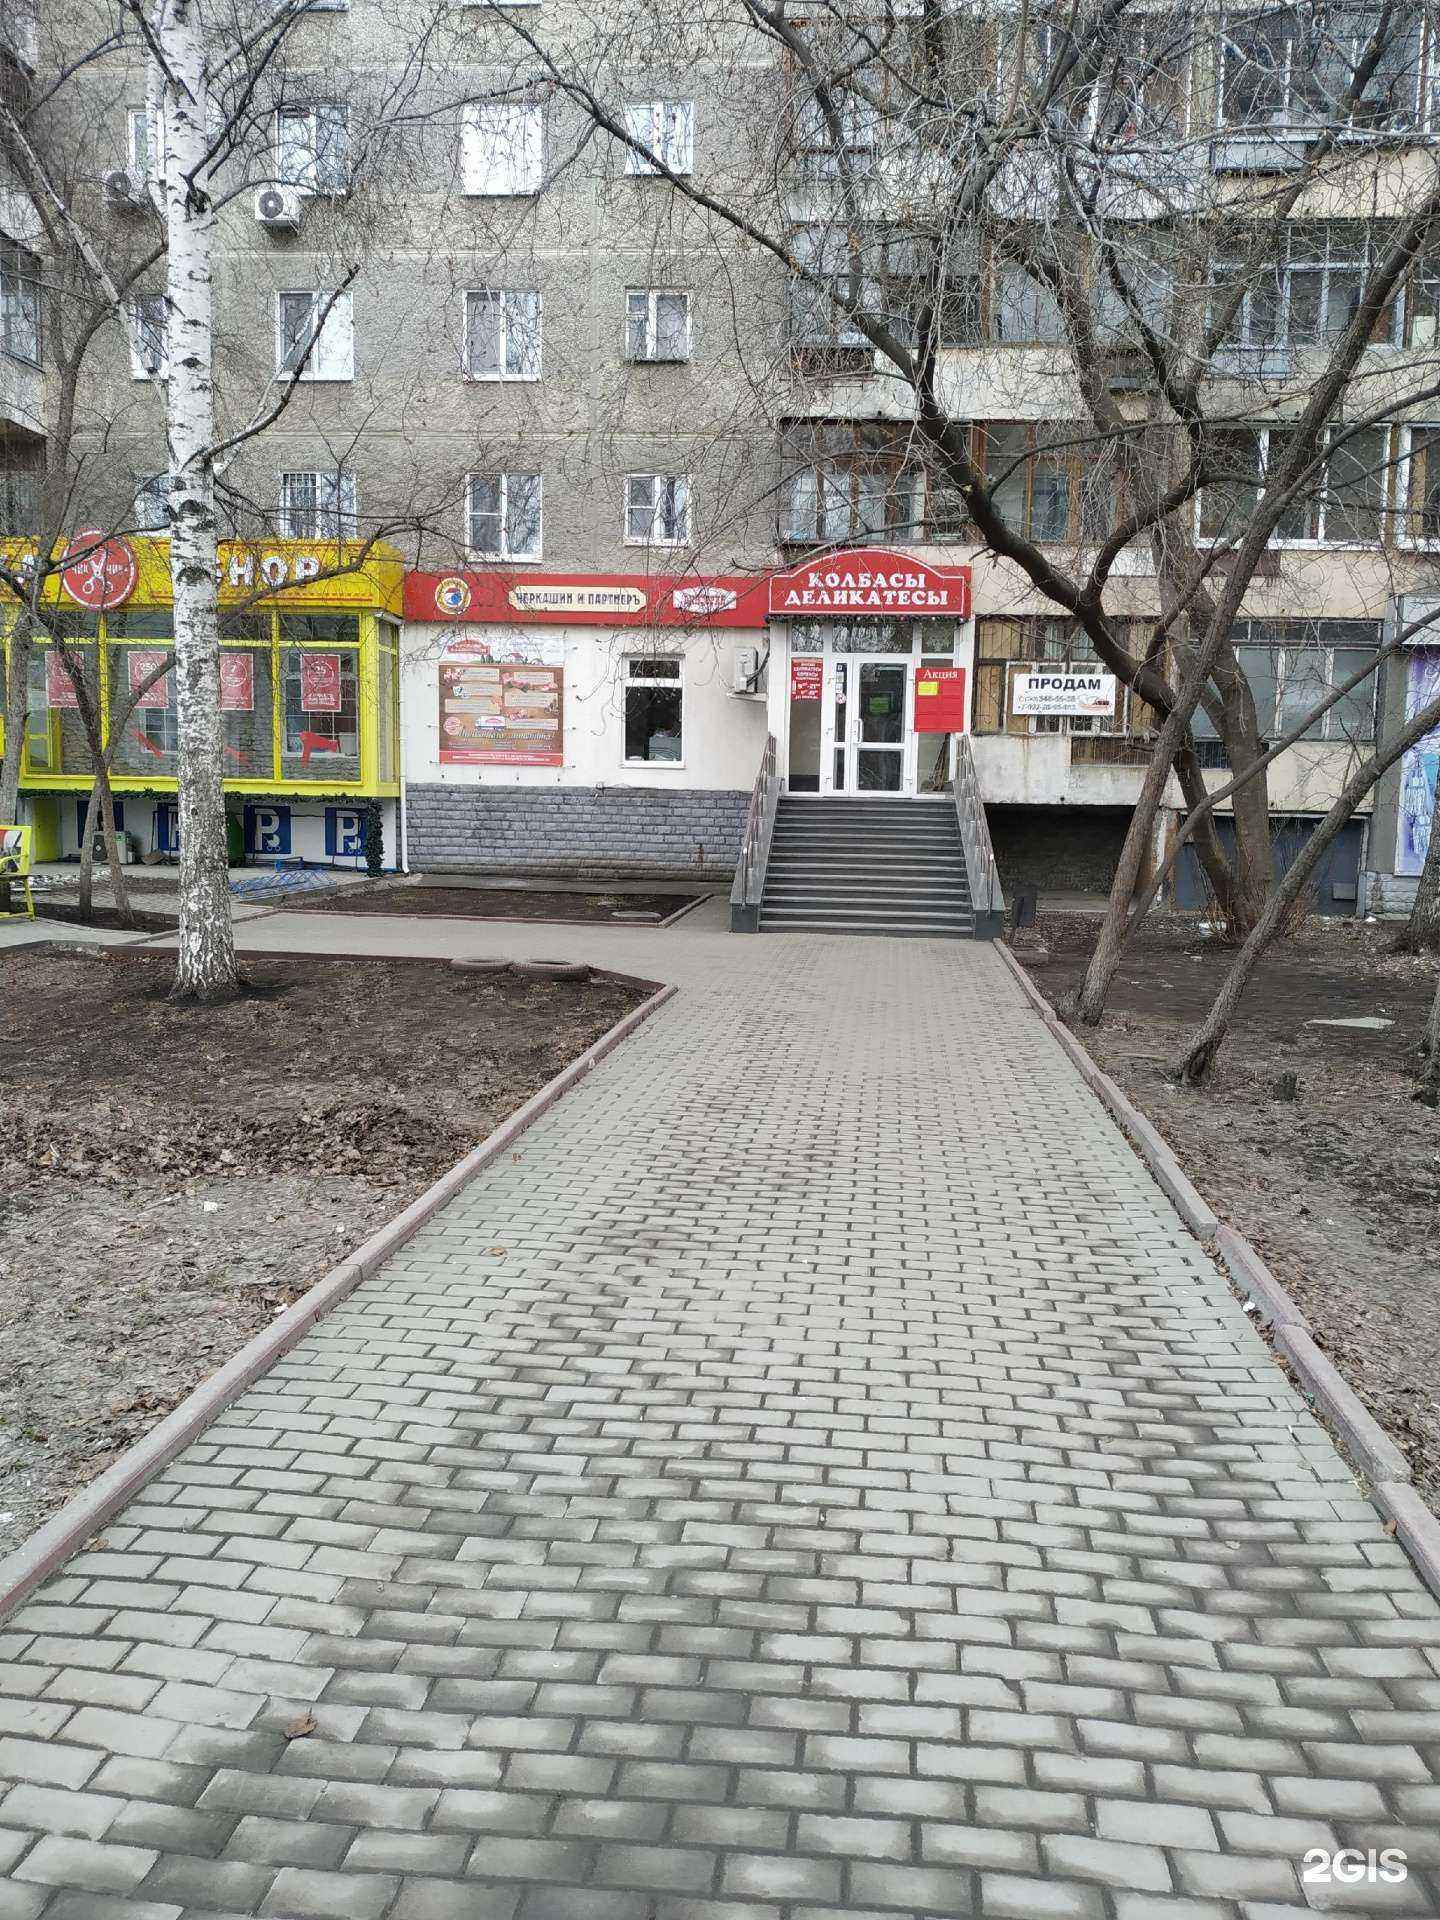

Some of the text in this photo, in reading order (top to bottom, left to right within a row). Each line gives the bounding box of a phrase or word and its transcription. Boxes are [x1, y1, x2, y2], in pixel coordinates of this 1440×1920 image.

[215, 555, 319, 588] HOP
[808, 572, 926, 588] КОЛБАСЫ
[515, 592, 640, 605] ЧЕРКАШИН И ПАРТНЕРЪ
[784, 589, 949, 606] ДЕЛИКАТЕСЫ
[1028, 678, 1101, 691] ПРОДАМ
